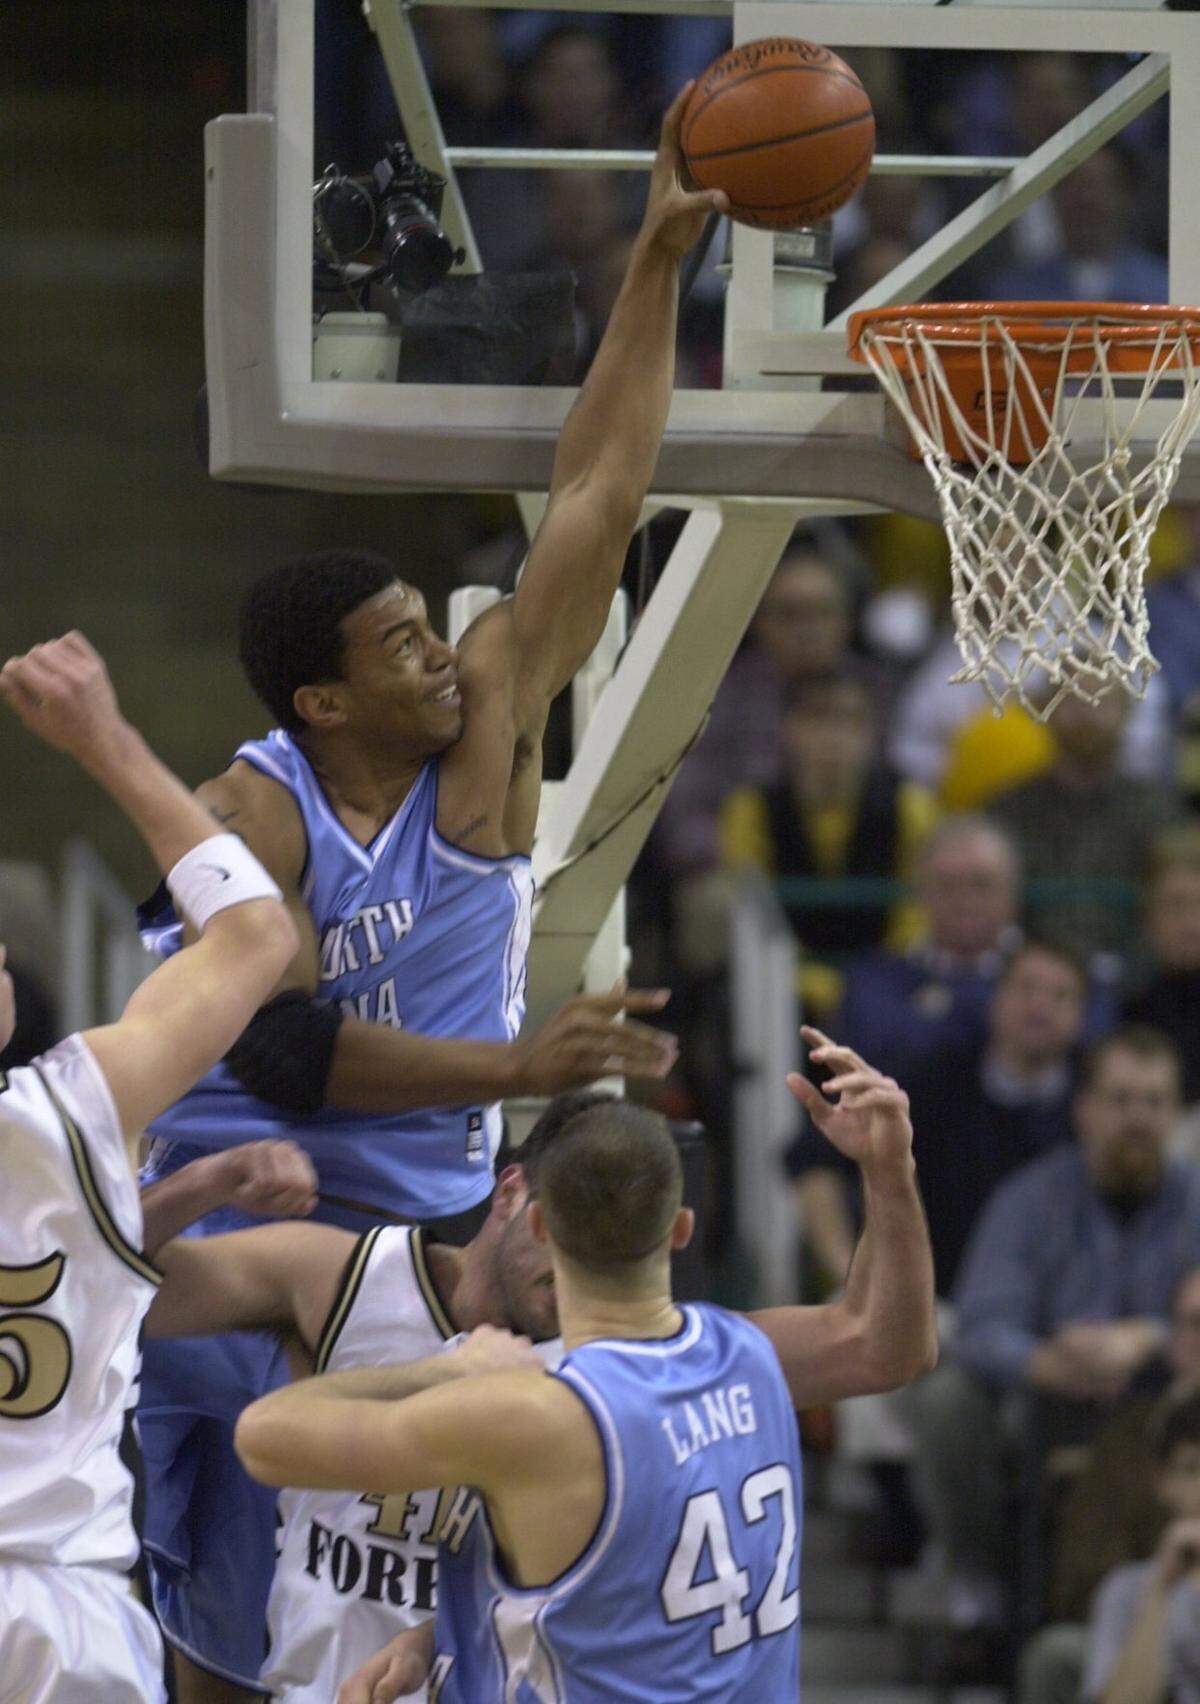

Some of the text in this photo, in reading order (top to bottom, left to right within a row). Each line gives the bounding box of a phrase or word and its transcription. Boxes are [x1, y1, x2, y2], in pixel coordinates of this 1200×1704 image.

[319, 898, 414, 981] ORTH
[661, 1384, 757, 1465] LANG
[306, 1519, 438, 1611] FORE
[660, 1461, 800, 1656] 42
